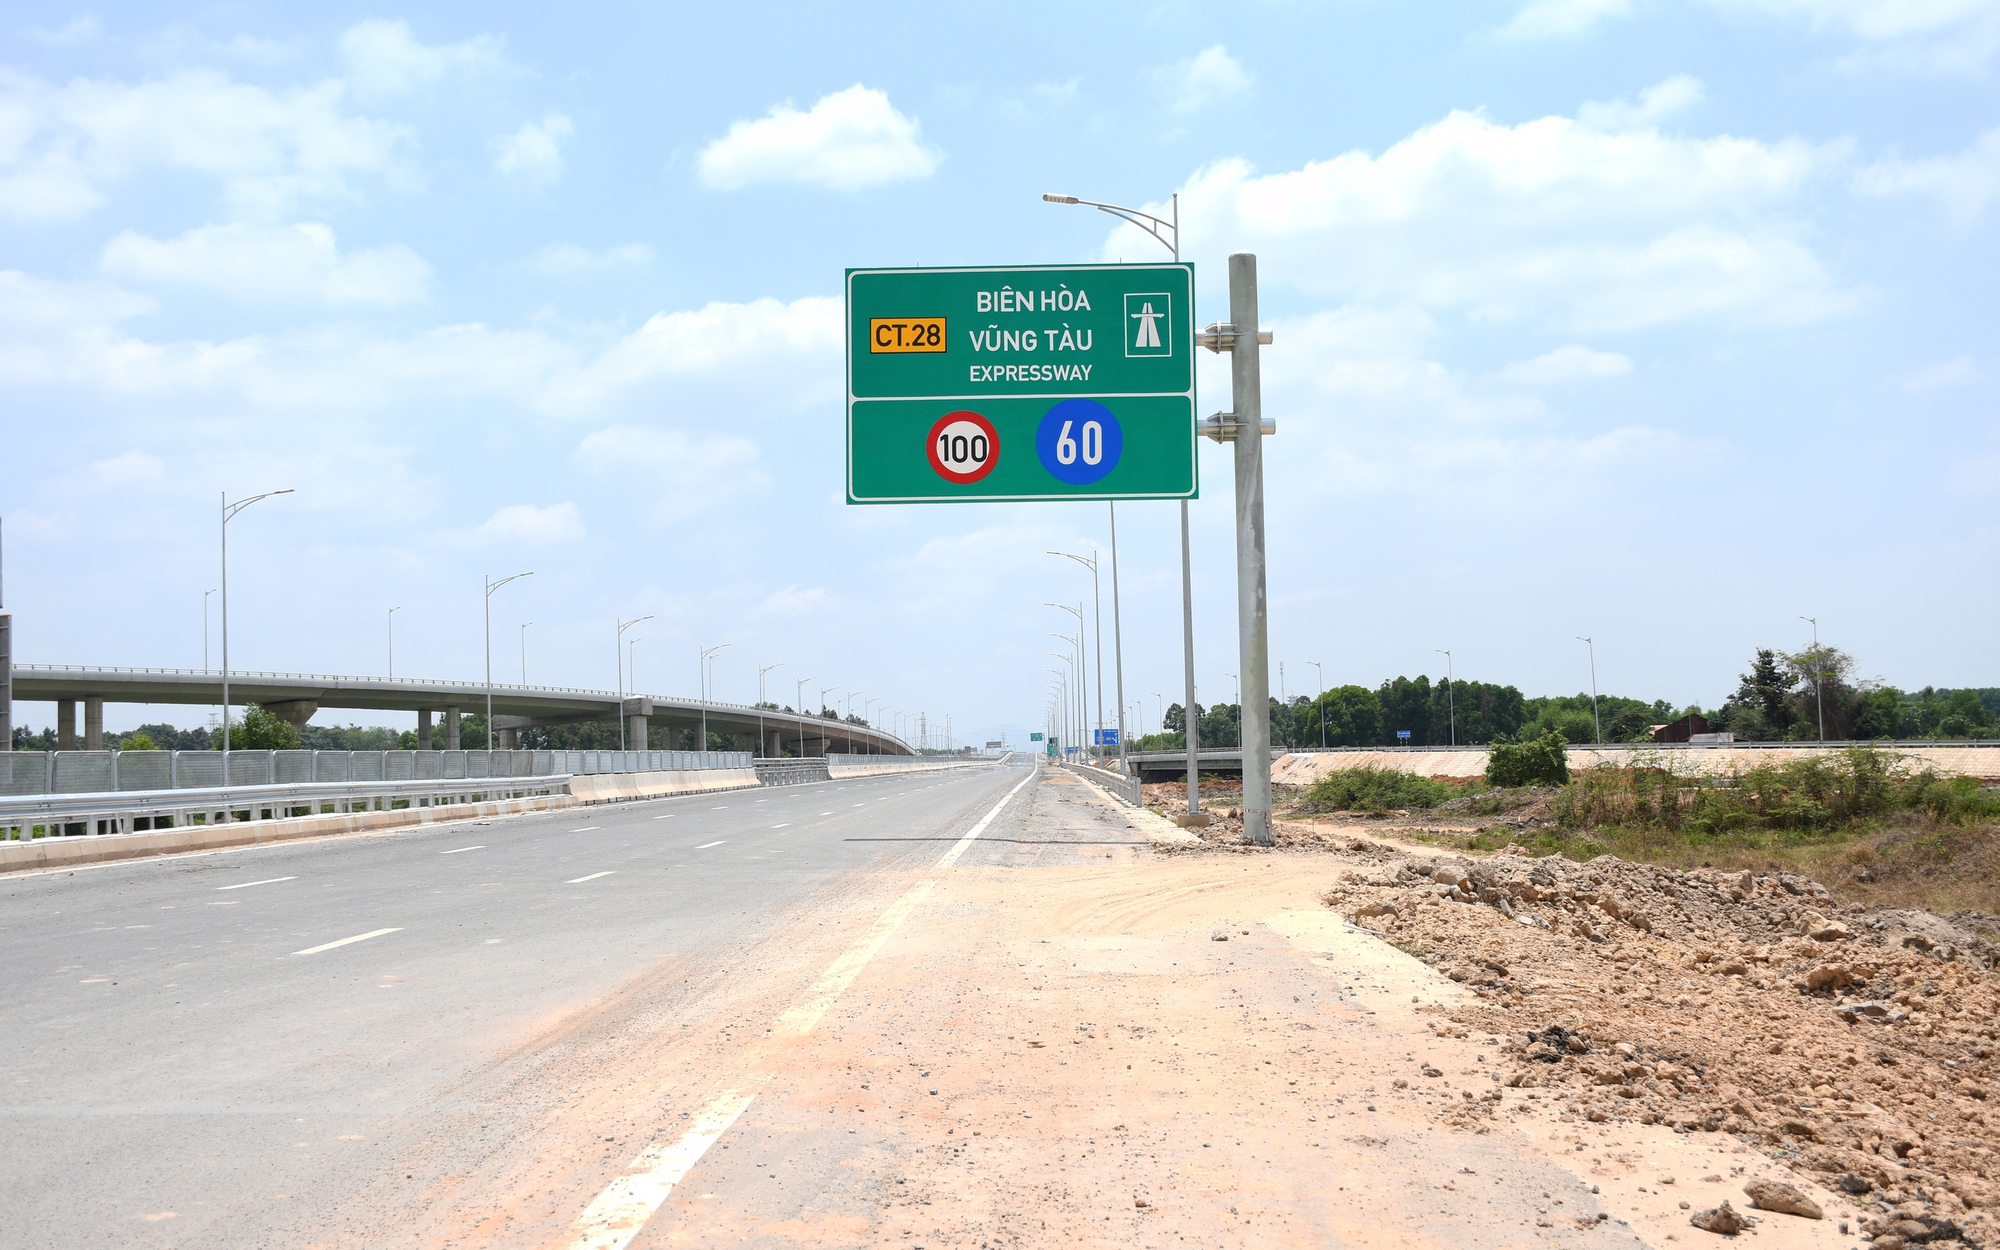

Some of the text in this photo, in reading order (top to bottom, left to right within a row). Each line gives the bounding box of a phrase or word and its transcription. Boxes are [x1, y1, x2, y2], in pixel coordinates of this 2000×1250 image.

[976, 283, 1091, 313] BIÊN HÒA
[875, 323, 942, 347] CT.28
[969, 322, 1093, 352] VŨNG TÀU
[970, 364, 1093, 382] EXPRESSWAY
[939, 433, 989, 464] 100
[1056, 420, 1103, 466] 60
